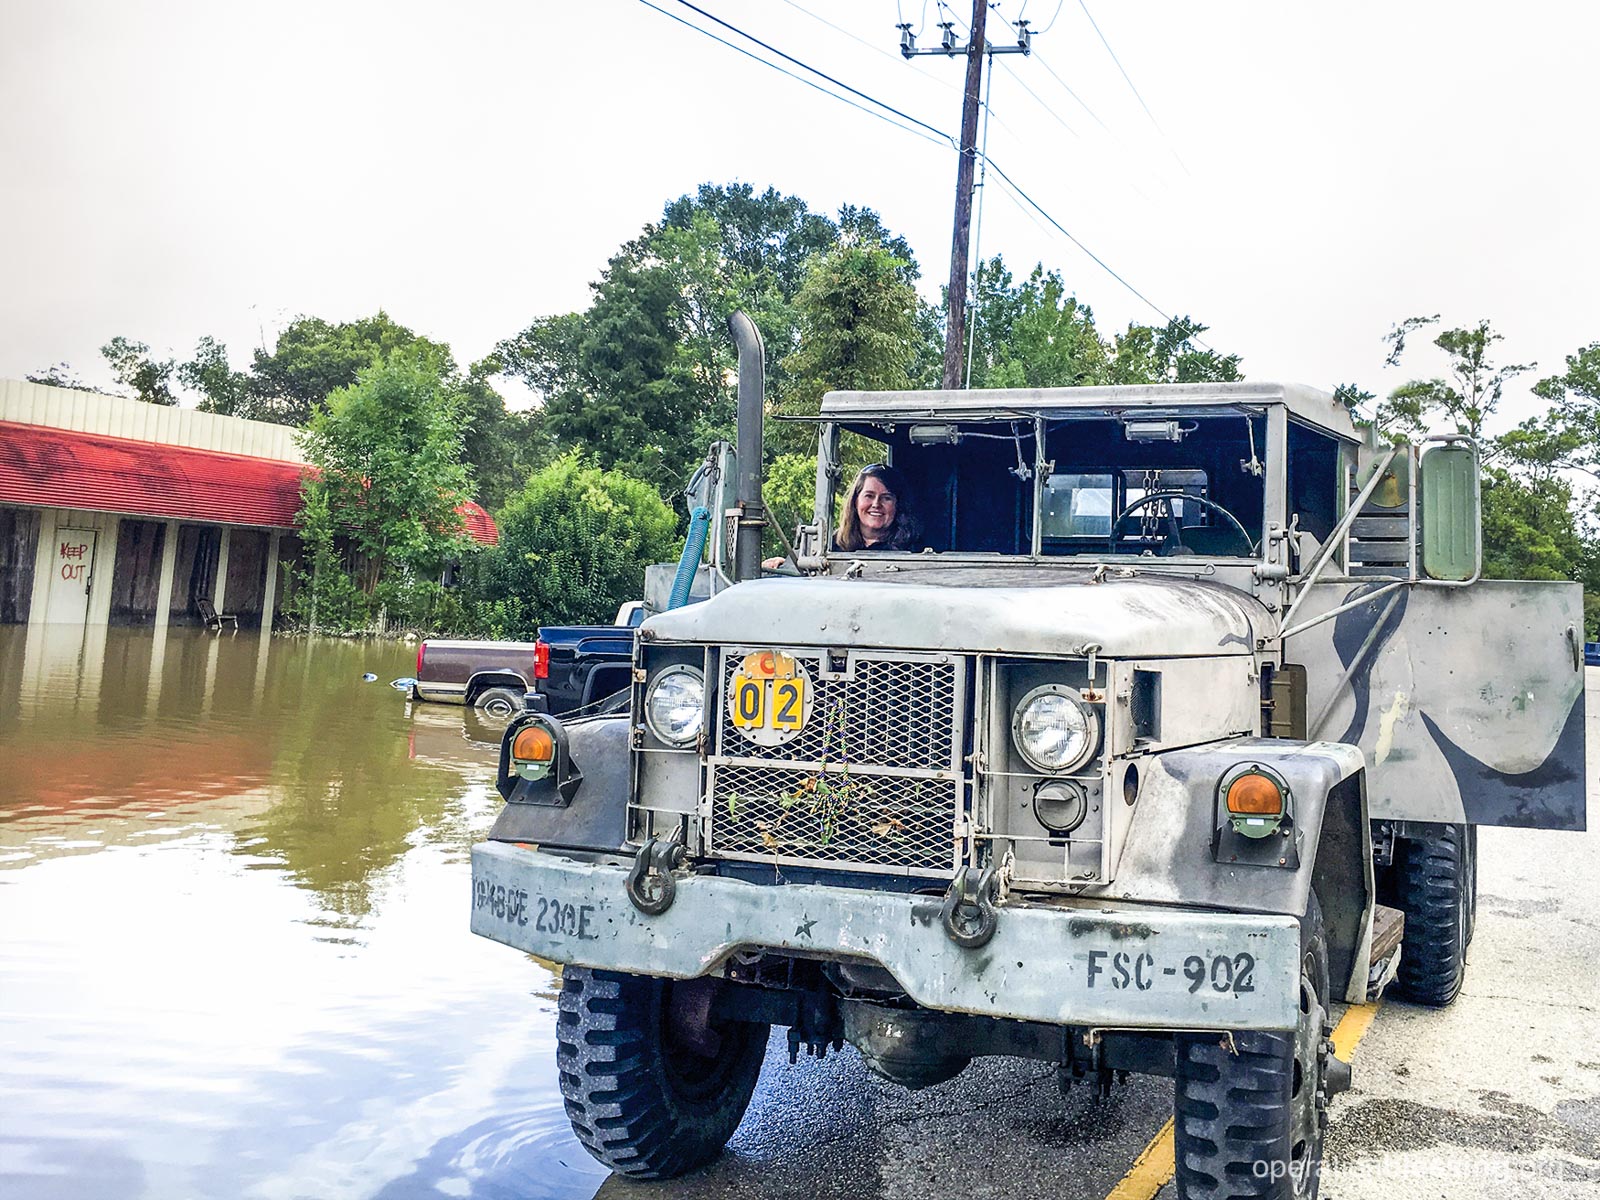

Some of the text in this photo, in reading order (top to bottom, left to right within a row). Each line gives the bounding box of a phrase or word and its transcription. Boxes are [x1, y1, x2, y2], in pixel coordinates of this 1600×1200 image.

[60, 542, 88, 561] KEEP
[61, 564, 86, 584] OUT
[1087, 950, 1255, 993] FSC-902
